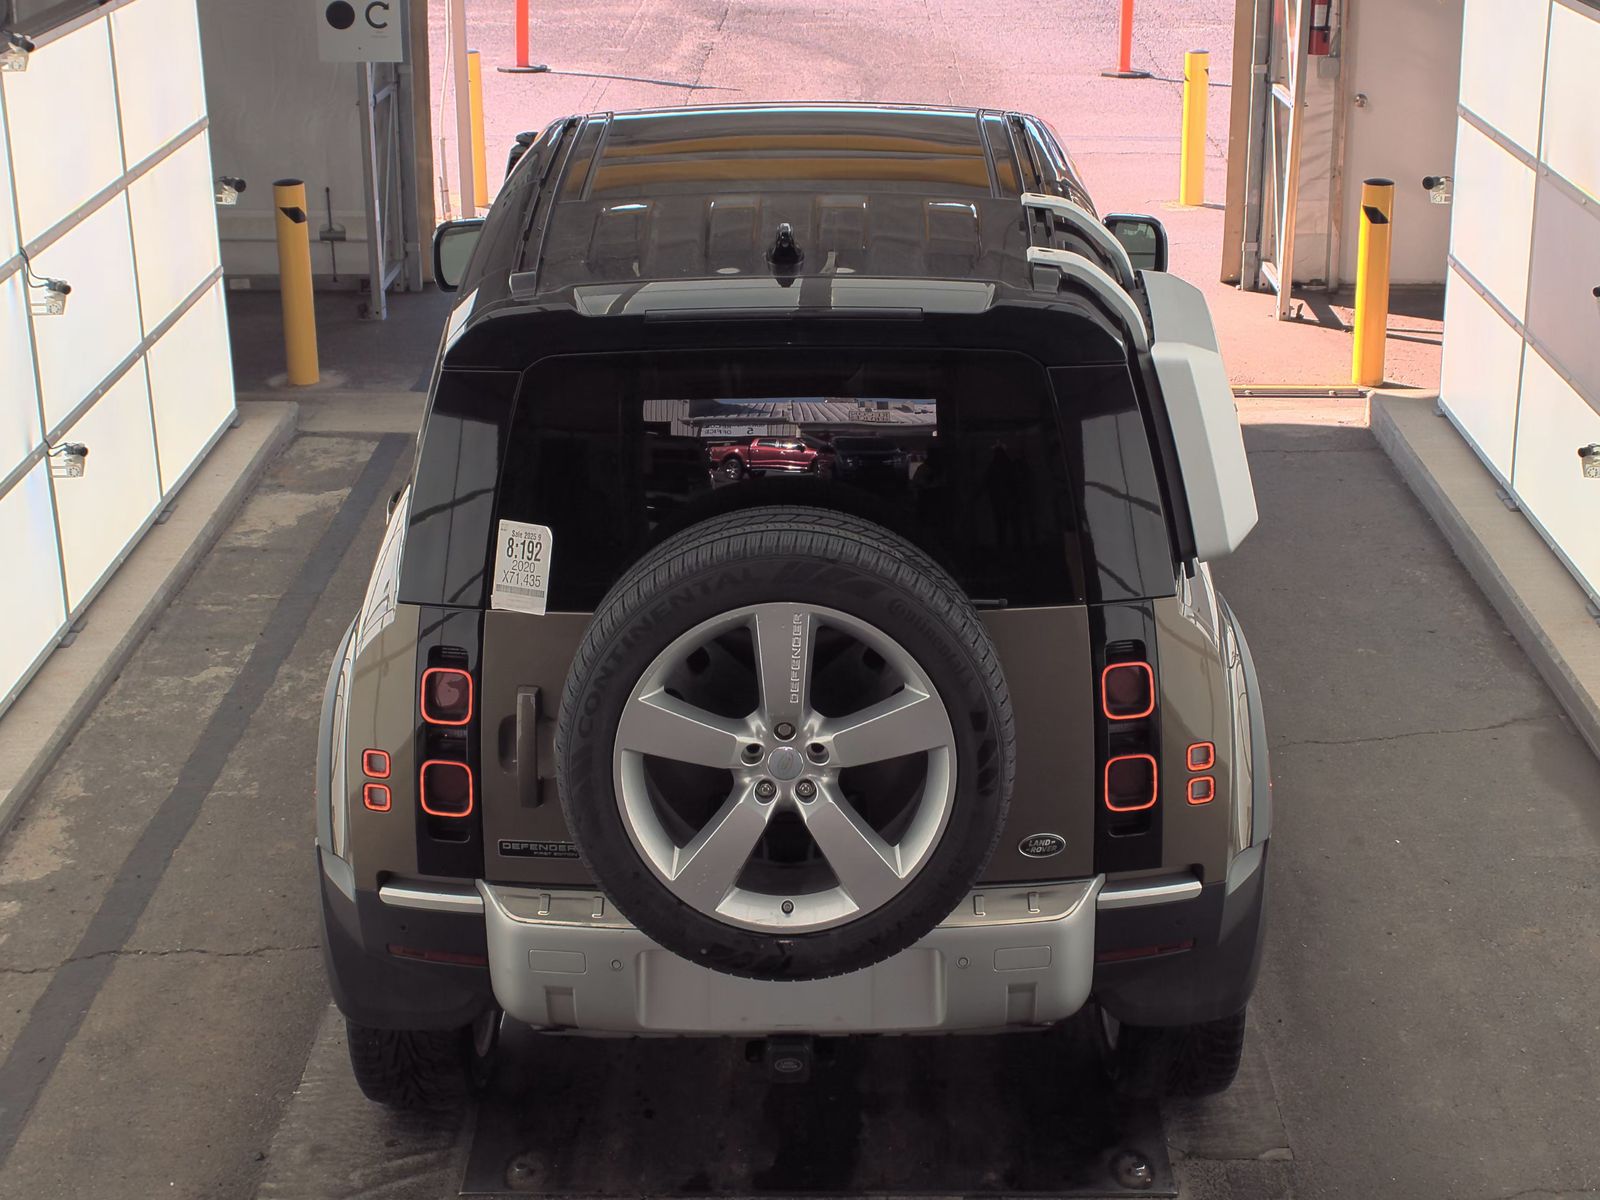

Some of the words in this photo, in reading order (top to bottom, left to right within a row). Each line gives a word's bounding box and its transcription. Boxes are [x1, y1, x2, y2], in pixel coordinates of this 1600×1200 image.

[524, 531, 537, 541] 2025
[506, 537, 543, 562] 8:192
[511, 560, 536, 574] 2020
[577, 566, 755, 738] CONTINENTAL
[789, 613, 803, 704] DEFENDER
[502, 842, 577, 852] DEFENDER
